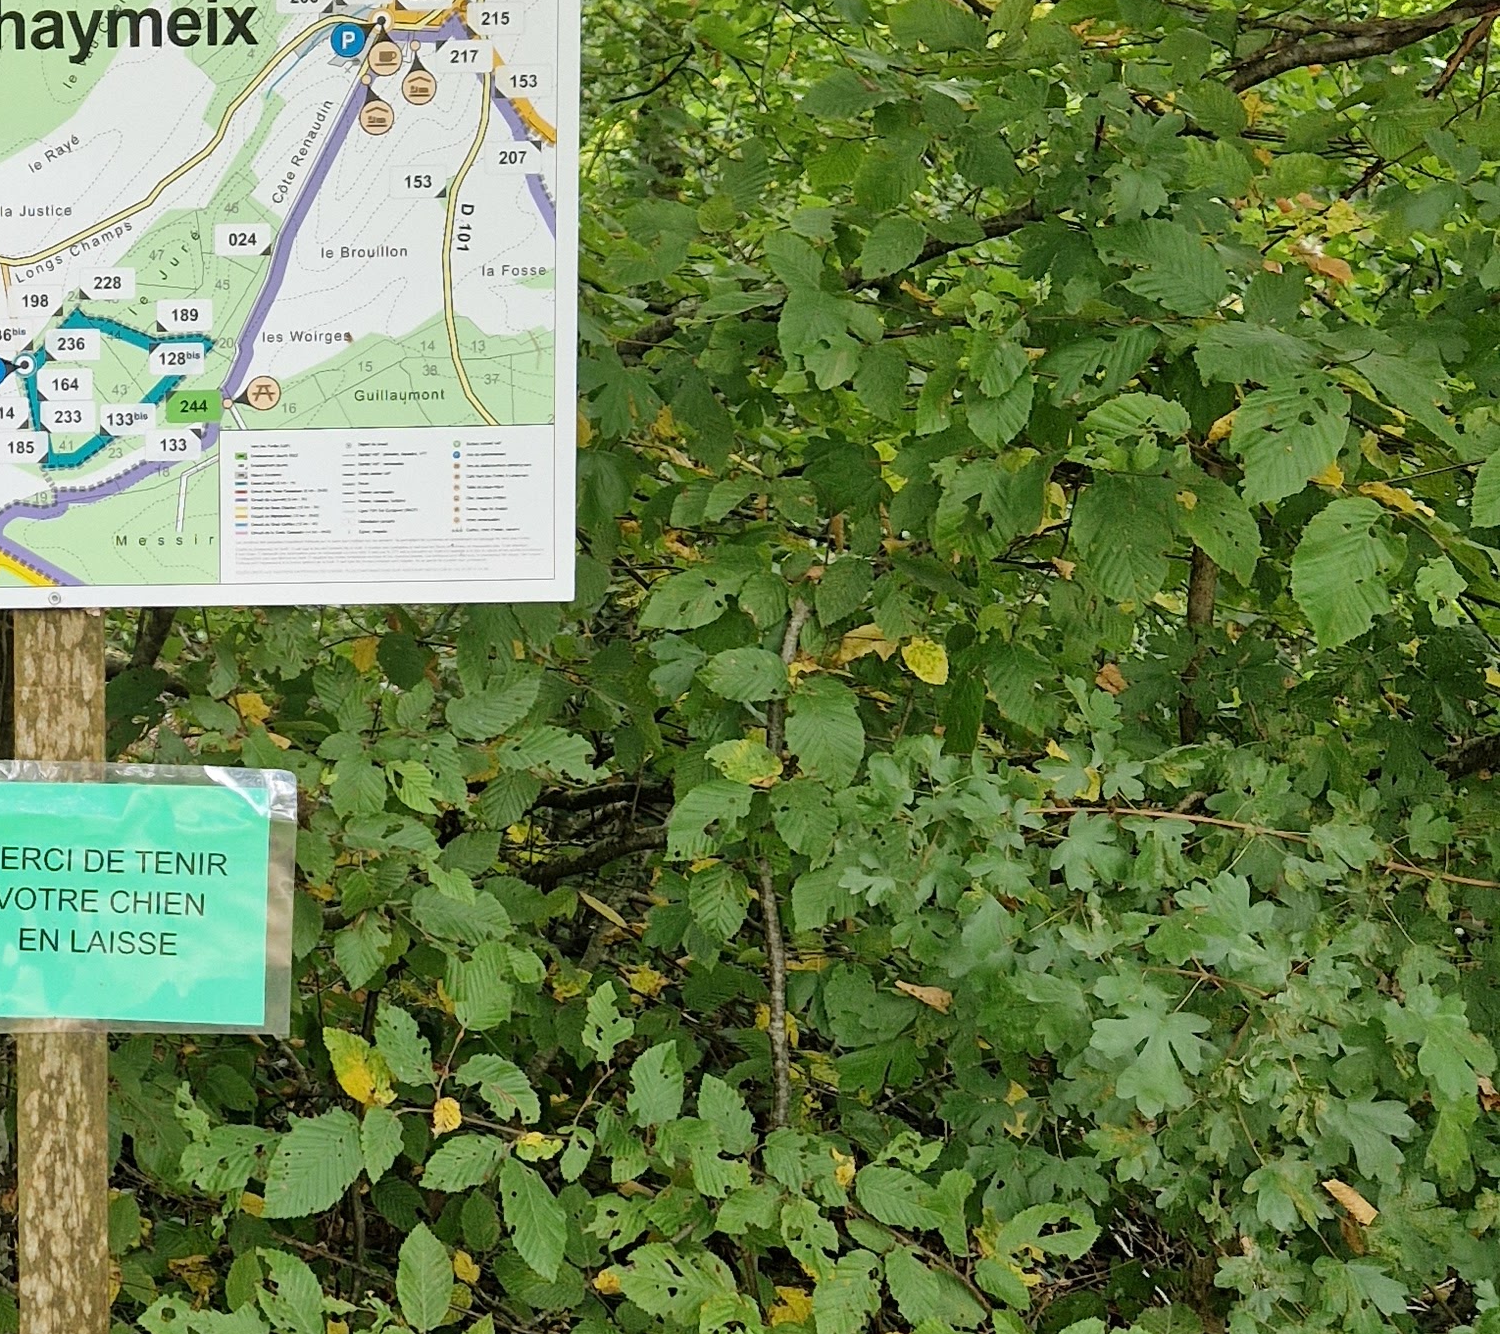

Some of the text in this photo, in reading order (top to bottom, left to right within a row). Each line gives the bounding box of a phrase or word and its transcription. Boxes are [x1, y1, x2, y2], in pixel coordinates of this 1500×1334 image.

[481, 12, 509, 26] 215
[342, 32, 356, 49] P
[450, 50, 478, 64] 217
[63, 75, 77, 89] le
[510, 74, 537, 88] 153
[29, 134, 81, 173] le Rayé
[272, 100, 334, 204] Côte Renaudin
[499, 151, 527, 165] 207
[404, 175, 432, 189] 153
[0, 205, 72, 217] la Justice
[457, 204, 474, 251] D 101
[228, 232, 257, 246] 024
[15, 219, 133, 283] Longs Champs
[321, 246, 407, 258] le Brouillon
[482, 265, 546, 276] la Fosse
[94, 277, 121, 289] 228
[215, 281, 230, 290] 45
[22, 295, 48, 307] 198
[172, 309, 198, 321] 189
[58, 338, 85, 350] 236
[219, 338, 233, 349] 20
[263, 332, 351, 345] les Woirges
[421, 341, 435, 351] 14
[471, 340, 485, 353] 13
[359, 362, 372, 372] 15
[52, 378, 79, 391] 164
[354, 389, 445, 401] Guillaumont
[180, 400, 208, 412] 244
[282, 404, 296, 413] 16
[55, 411, 82, 423] 233
[7, 441, 34, 454] 185
[160, 439, 187, 451] 133
[108, 448, 122, 458] 23
[85, 849, 124, 874] DE
[135, 850, 227, 876] TENIR
[110, 890, 205, 916] CHIEN
[19, 928, 177, 956] EN LAISSE
